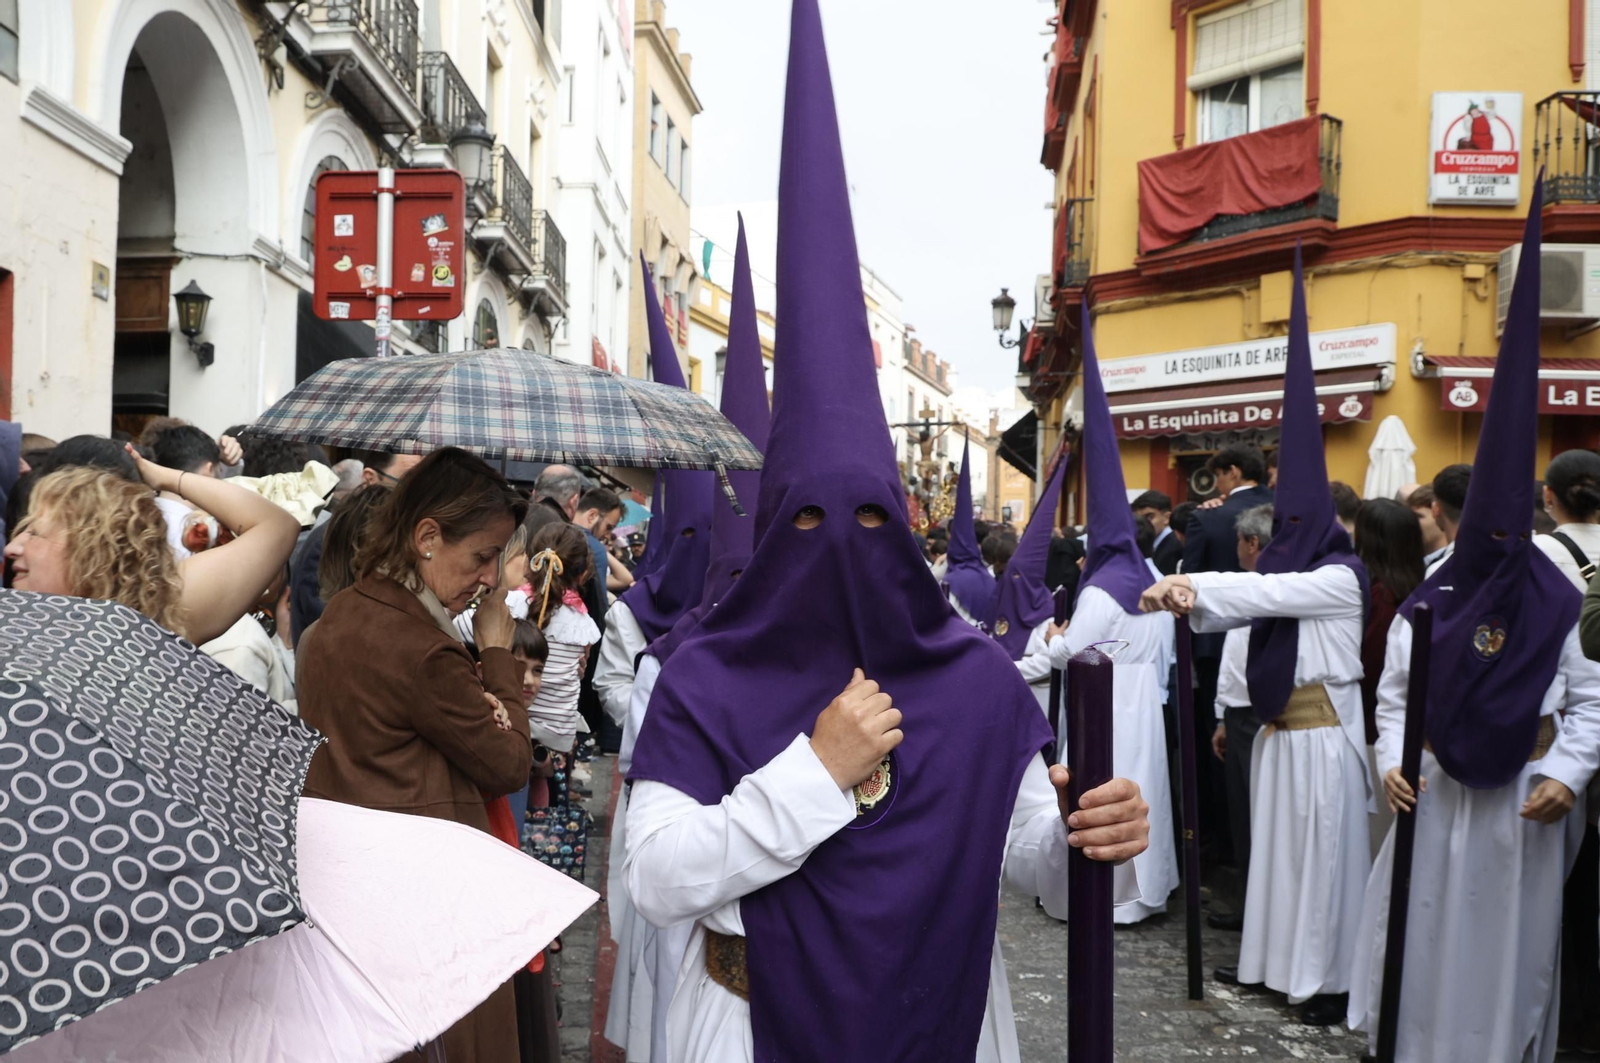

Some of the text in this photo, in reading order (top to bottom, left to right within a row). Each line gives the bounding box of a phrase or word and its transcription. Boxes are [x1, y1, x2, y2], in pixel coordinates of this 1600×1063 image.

[1441, 152, 1515, 169] Cruzcampo
[1448, 175, 1510, 185] LA ESQUINITA
[1458, 186, 1496, 196] DE ARFE
[1319, 336, 1379, 352] Cruzcampo
[1165, 345, 1289, 376] LA ESQUINITA DE ARF
[1101, 364, 1147, 378] Cruzcampo
[1455, 391, 1473, 402] AB
[1547, 384, 1579, 406] La
[1123, 416, 1145, 431] La
[1148, 409, 1238, 431] Esquinita
[1244, 405, 1273, 422] De
